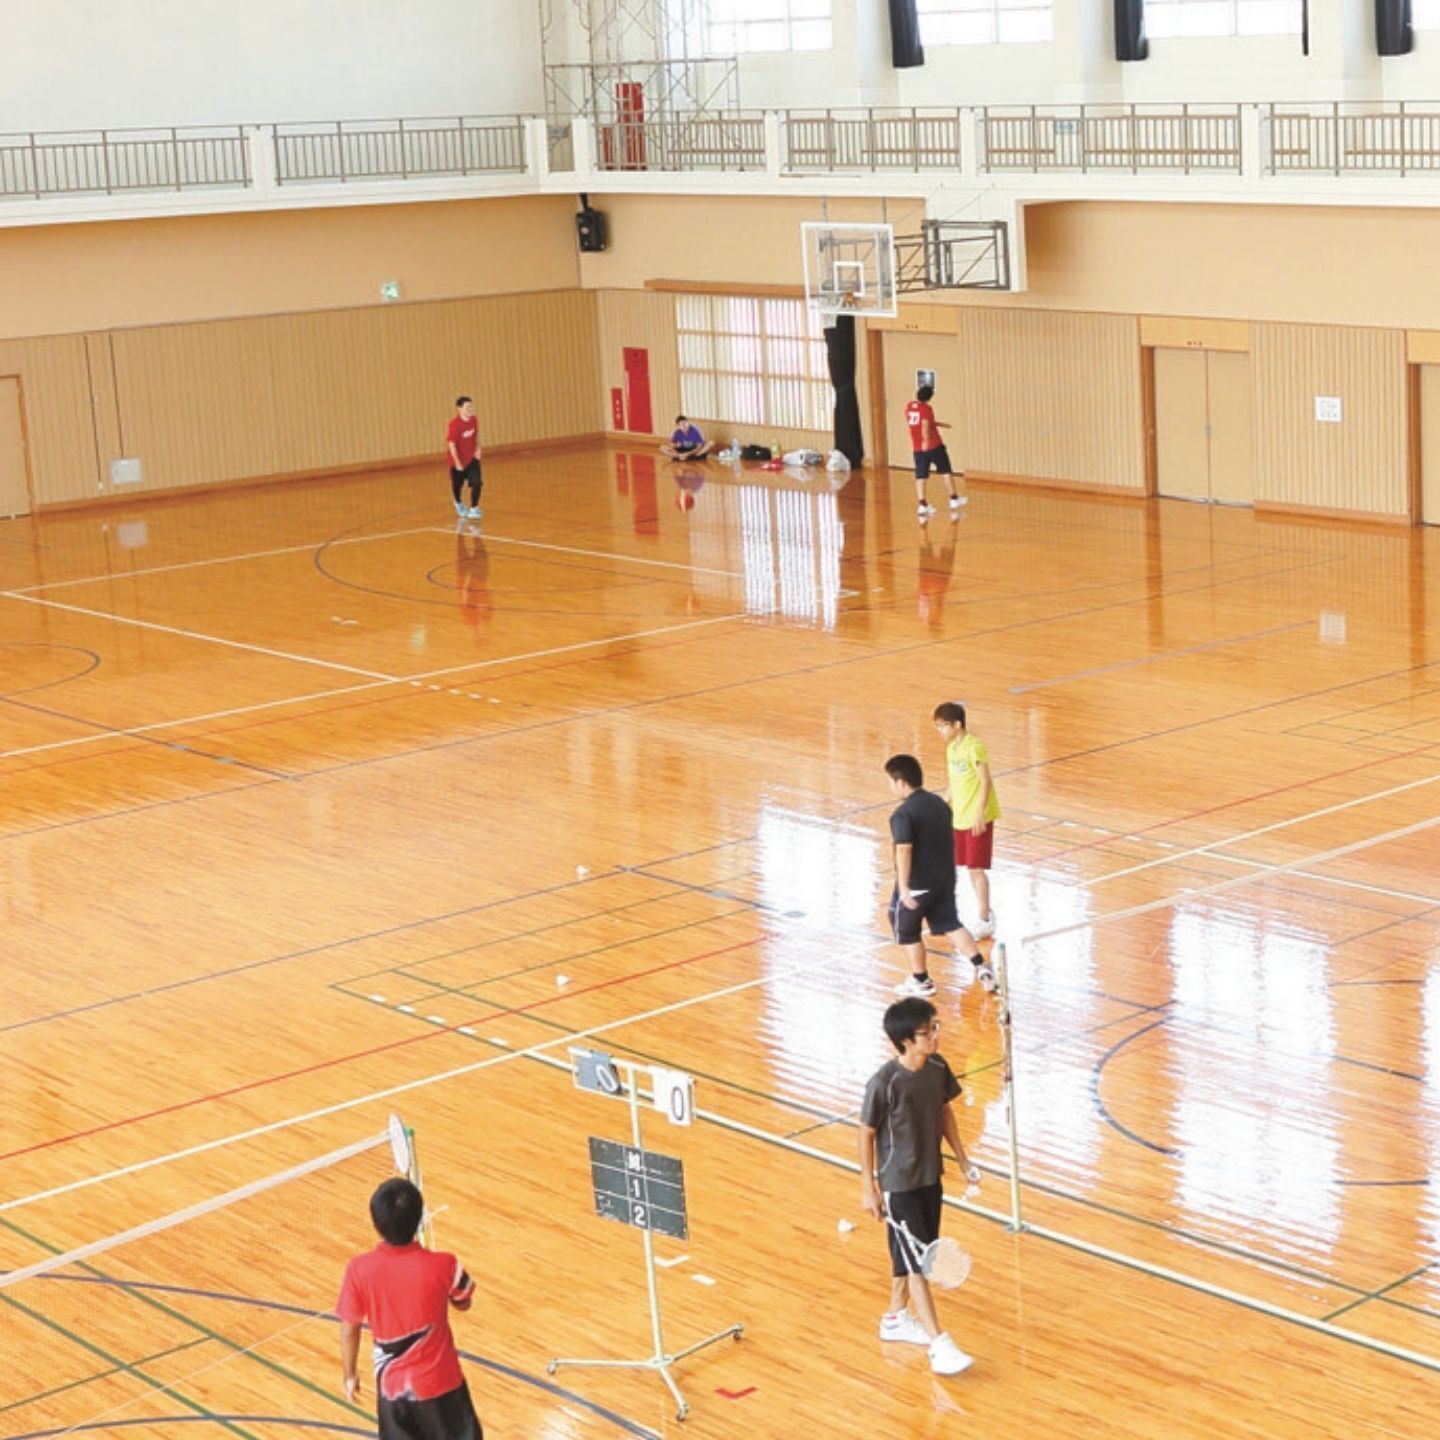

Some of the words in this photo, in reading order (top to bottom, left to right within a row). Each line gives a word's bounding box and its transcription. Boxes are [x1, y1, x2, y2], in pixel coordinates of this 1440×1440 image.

[595, 1063, 618, 1092] 0
[671, 1085, 685, 1121] 0
[632, 1179, 641, 1198] 1
[633, 1207, 646, 1226] 2
